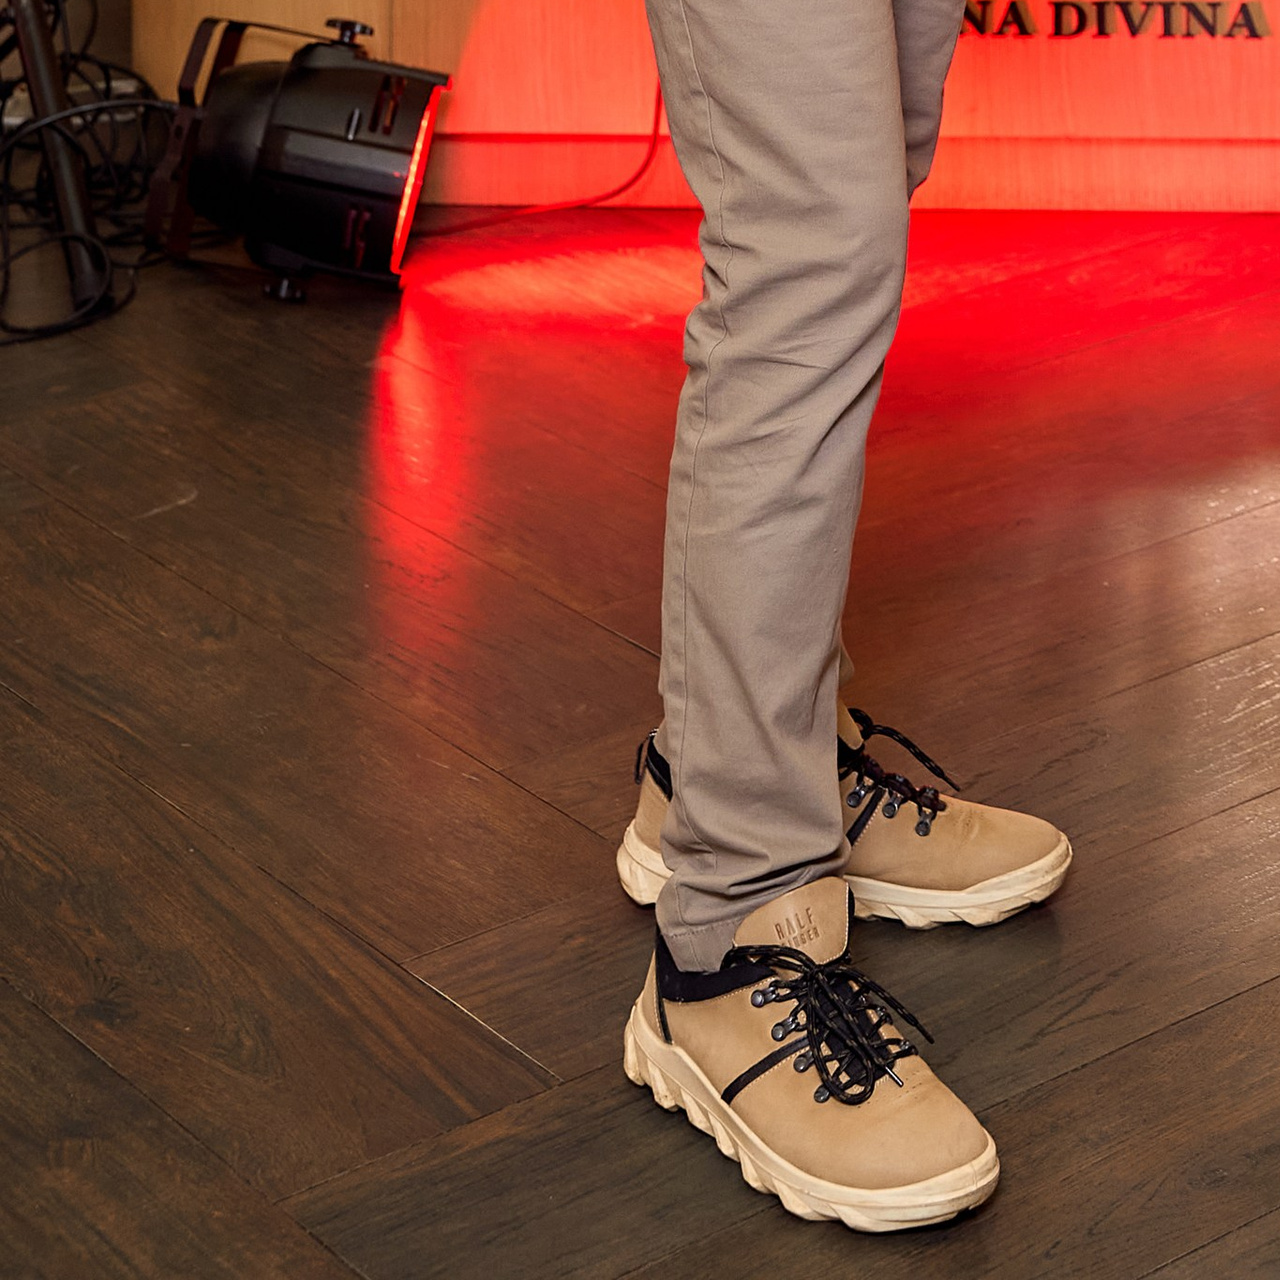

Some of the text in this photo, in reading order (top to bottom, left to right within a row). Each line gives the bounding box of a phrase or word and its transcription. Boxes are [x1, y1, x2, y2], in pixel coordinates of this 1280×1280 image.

[1049, 0, 1264, 40] DIVINA
[775, 907, 813, 940] RALF
[781, 927, 820, 947] INGER
